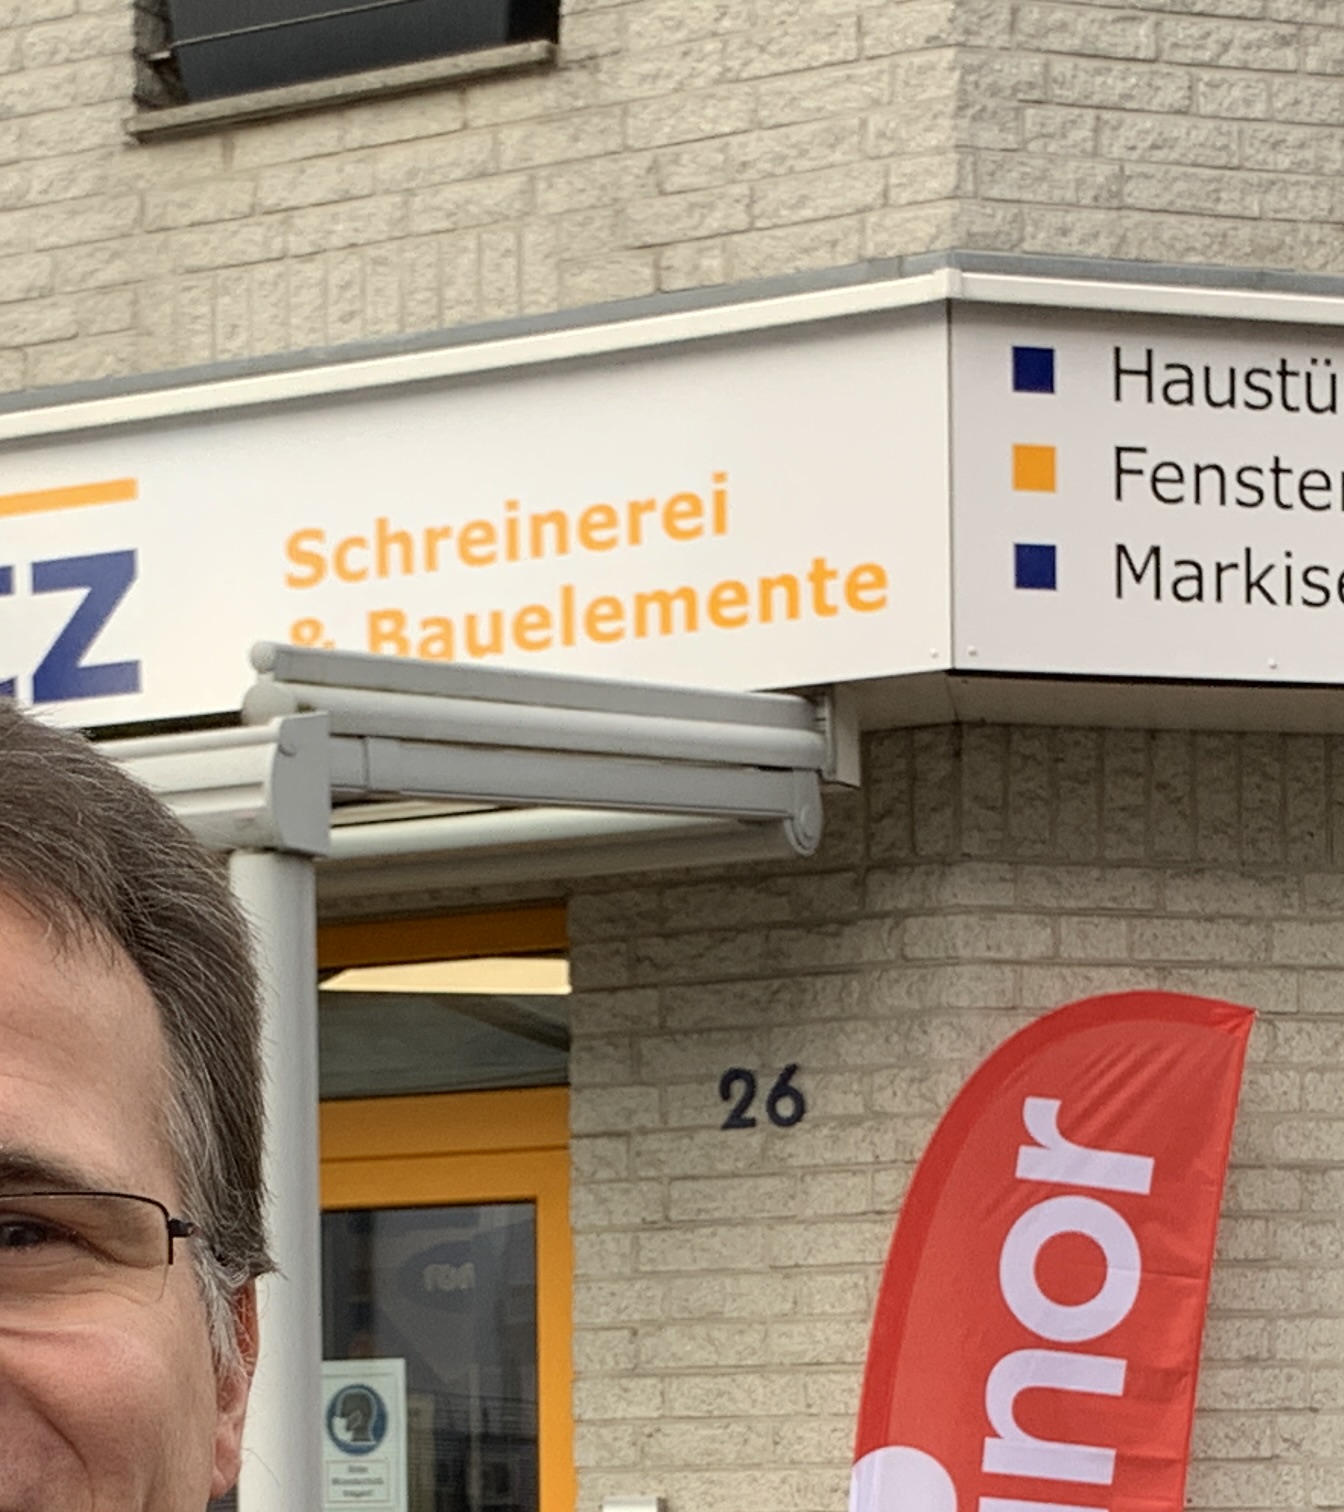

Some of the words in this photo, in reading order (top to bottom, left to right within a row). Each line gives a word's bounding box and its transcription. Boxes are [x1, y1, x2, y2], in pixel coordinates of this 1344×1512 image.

[283, 471, 729, 590] Schreinerei
[366, 557, 890, 663] Bauelemente
[719, 1063, 806, 1130] 26
